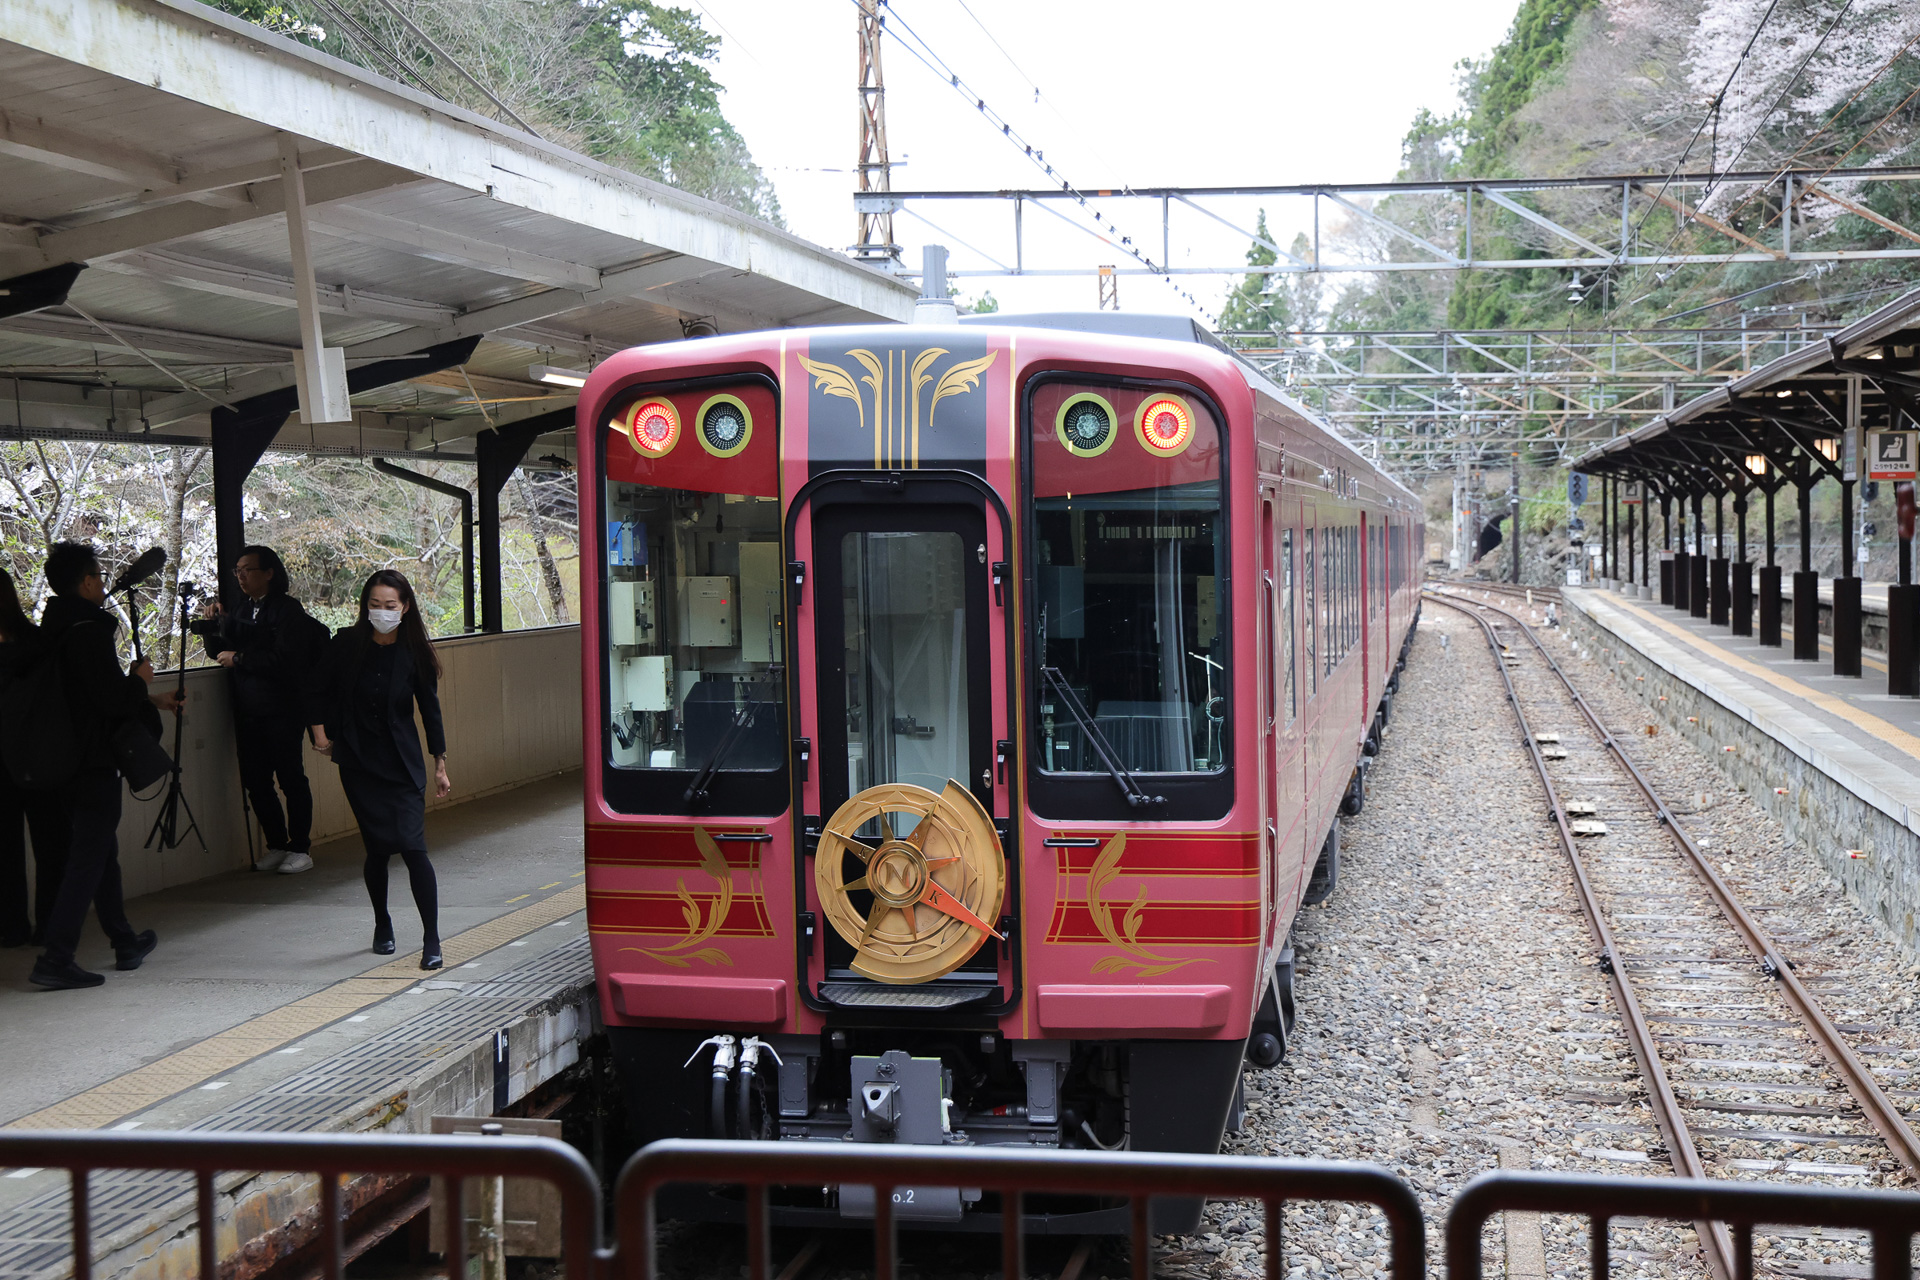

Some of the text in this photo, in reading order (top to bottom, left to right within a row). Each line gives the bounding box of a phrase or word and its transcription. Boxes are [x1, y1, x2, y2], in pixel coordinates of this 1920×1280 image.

[884, 860, 910, 890] N
[928, 890, 943, 906] K
[892, 1189, 915, 1203] o.2
